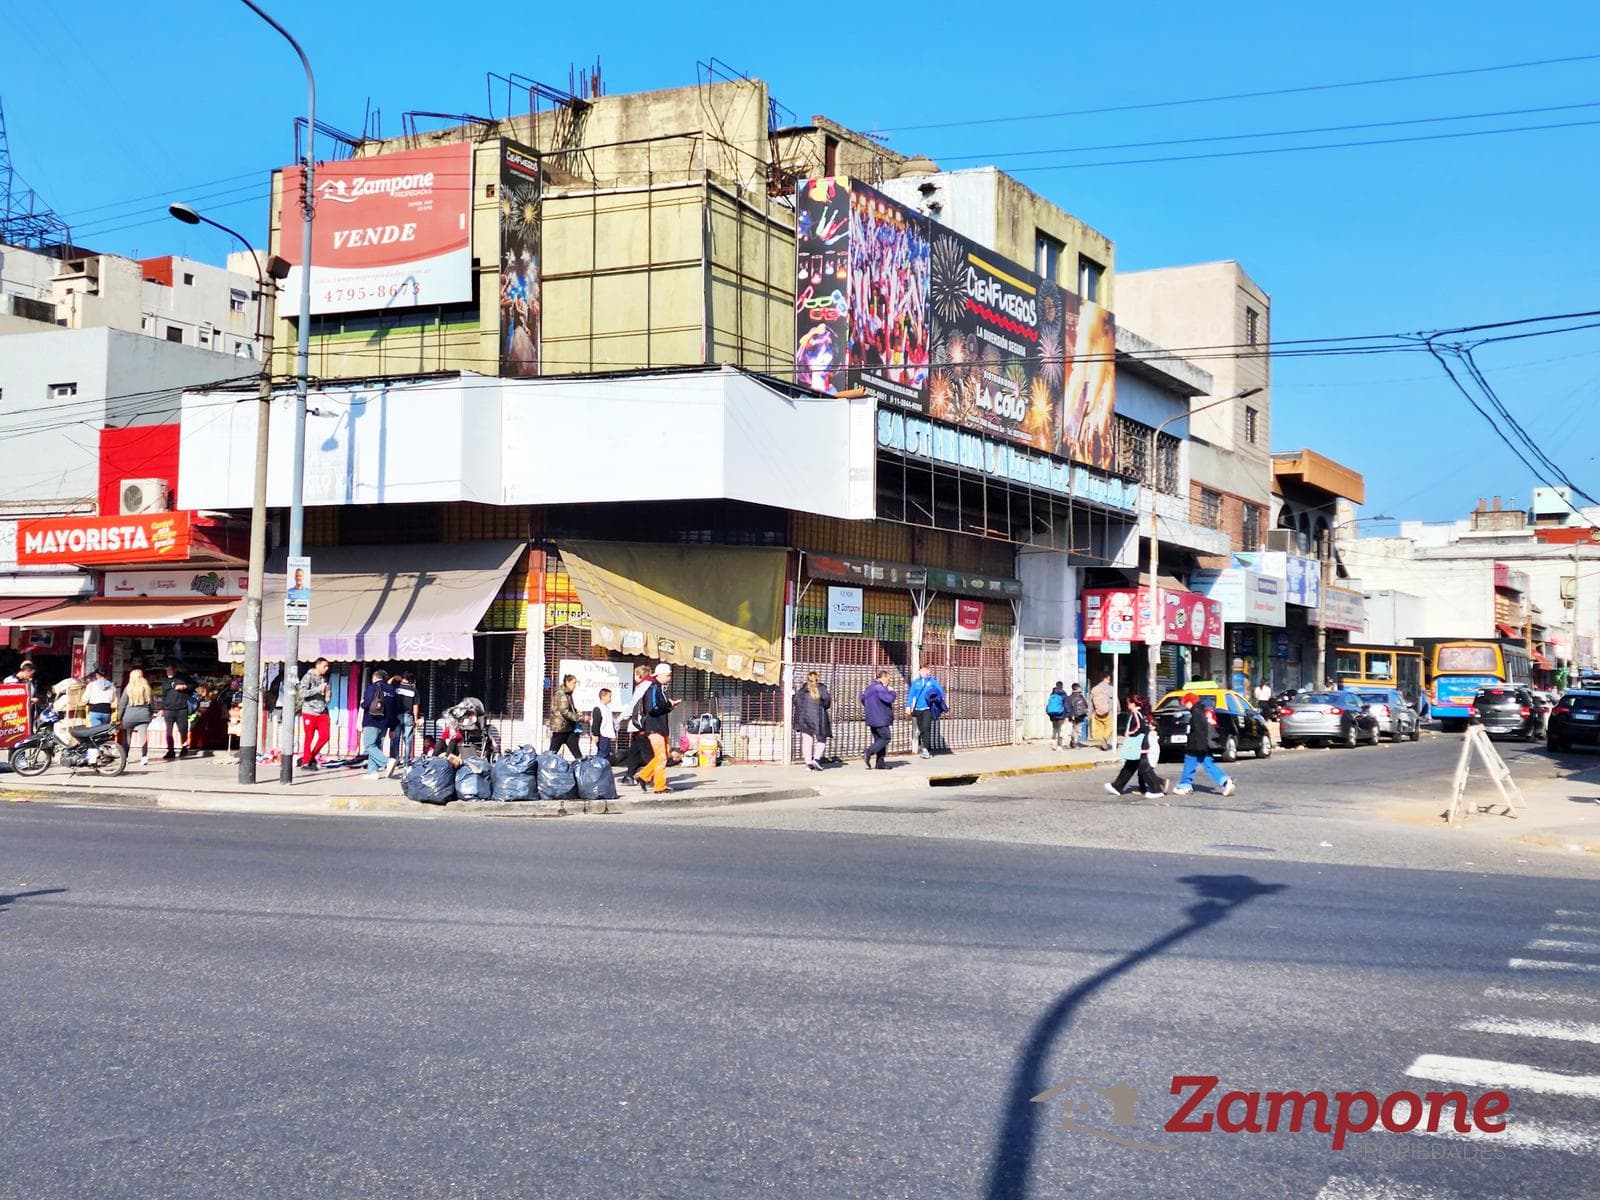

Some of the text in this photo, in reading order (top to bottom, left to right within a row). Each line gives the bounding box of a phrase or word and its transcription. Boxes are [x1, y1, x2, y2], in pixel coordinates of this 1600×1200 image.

[351, 172, 434, 197] Zampone
[333, 223, 417, 249] VENDE
[324, 282, 421, 302] 4795-8673
[976, 325, 984, 338] LA
[976, 383, 1026, 422] LA COLO
[25, 526, 149, 554] MAYORISTA
[585, 679, 629, 689] Zampone
